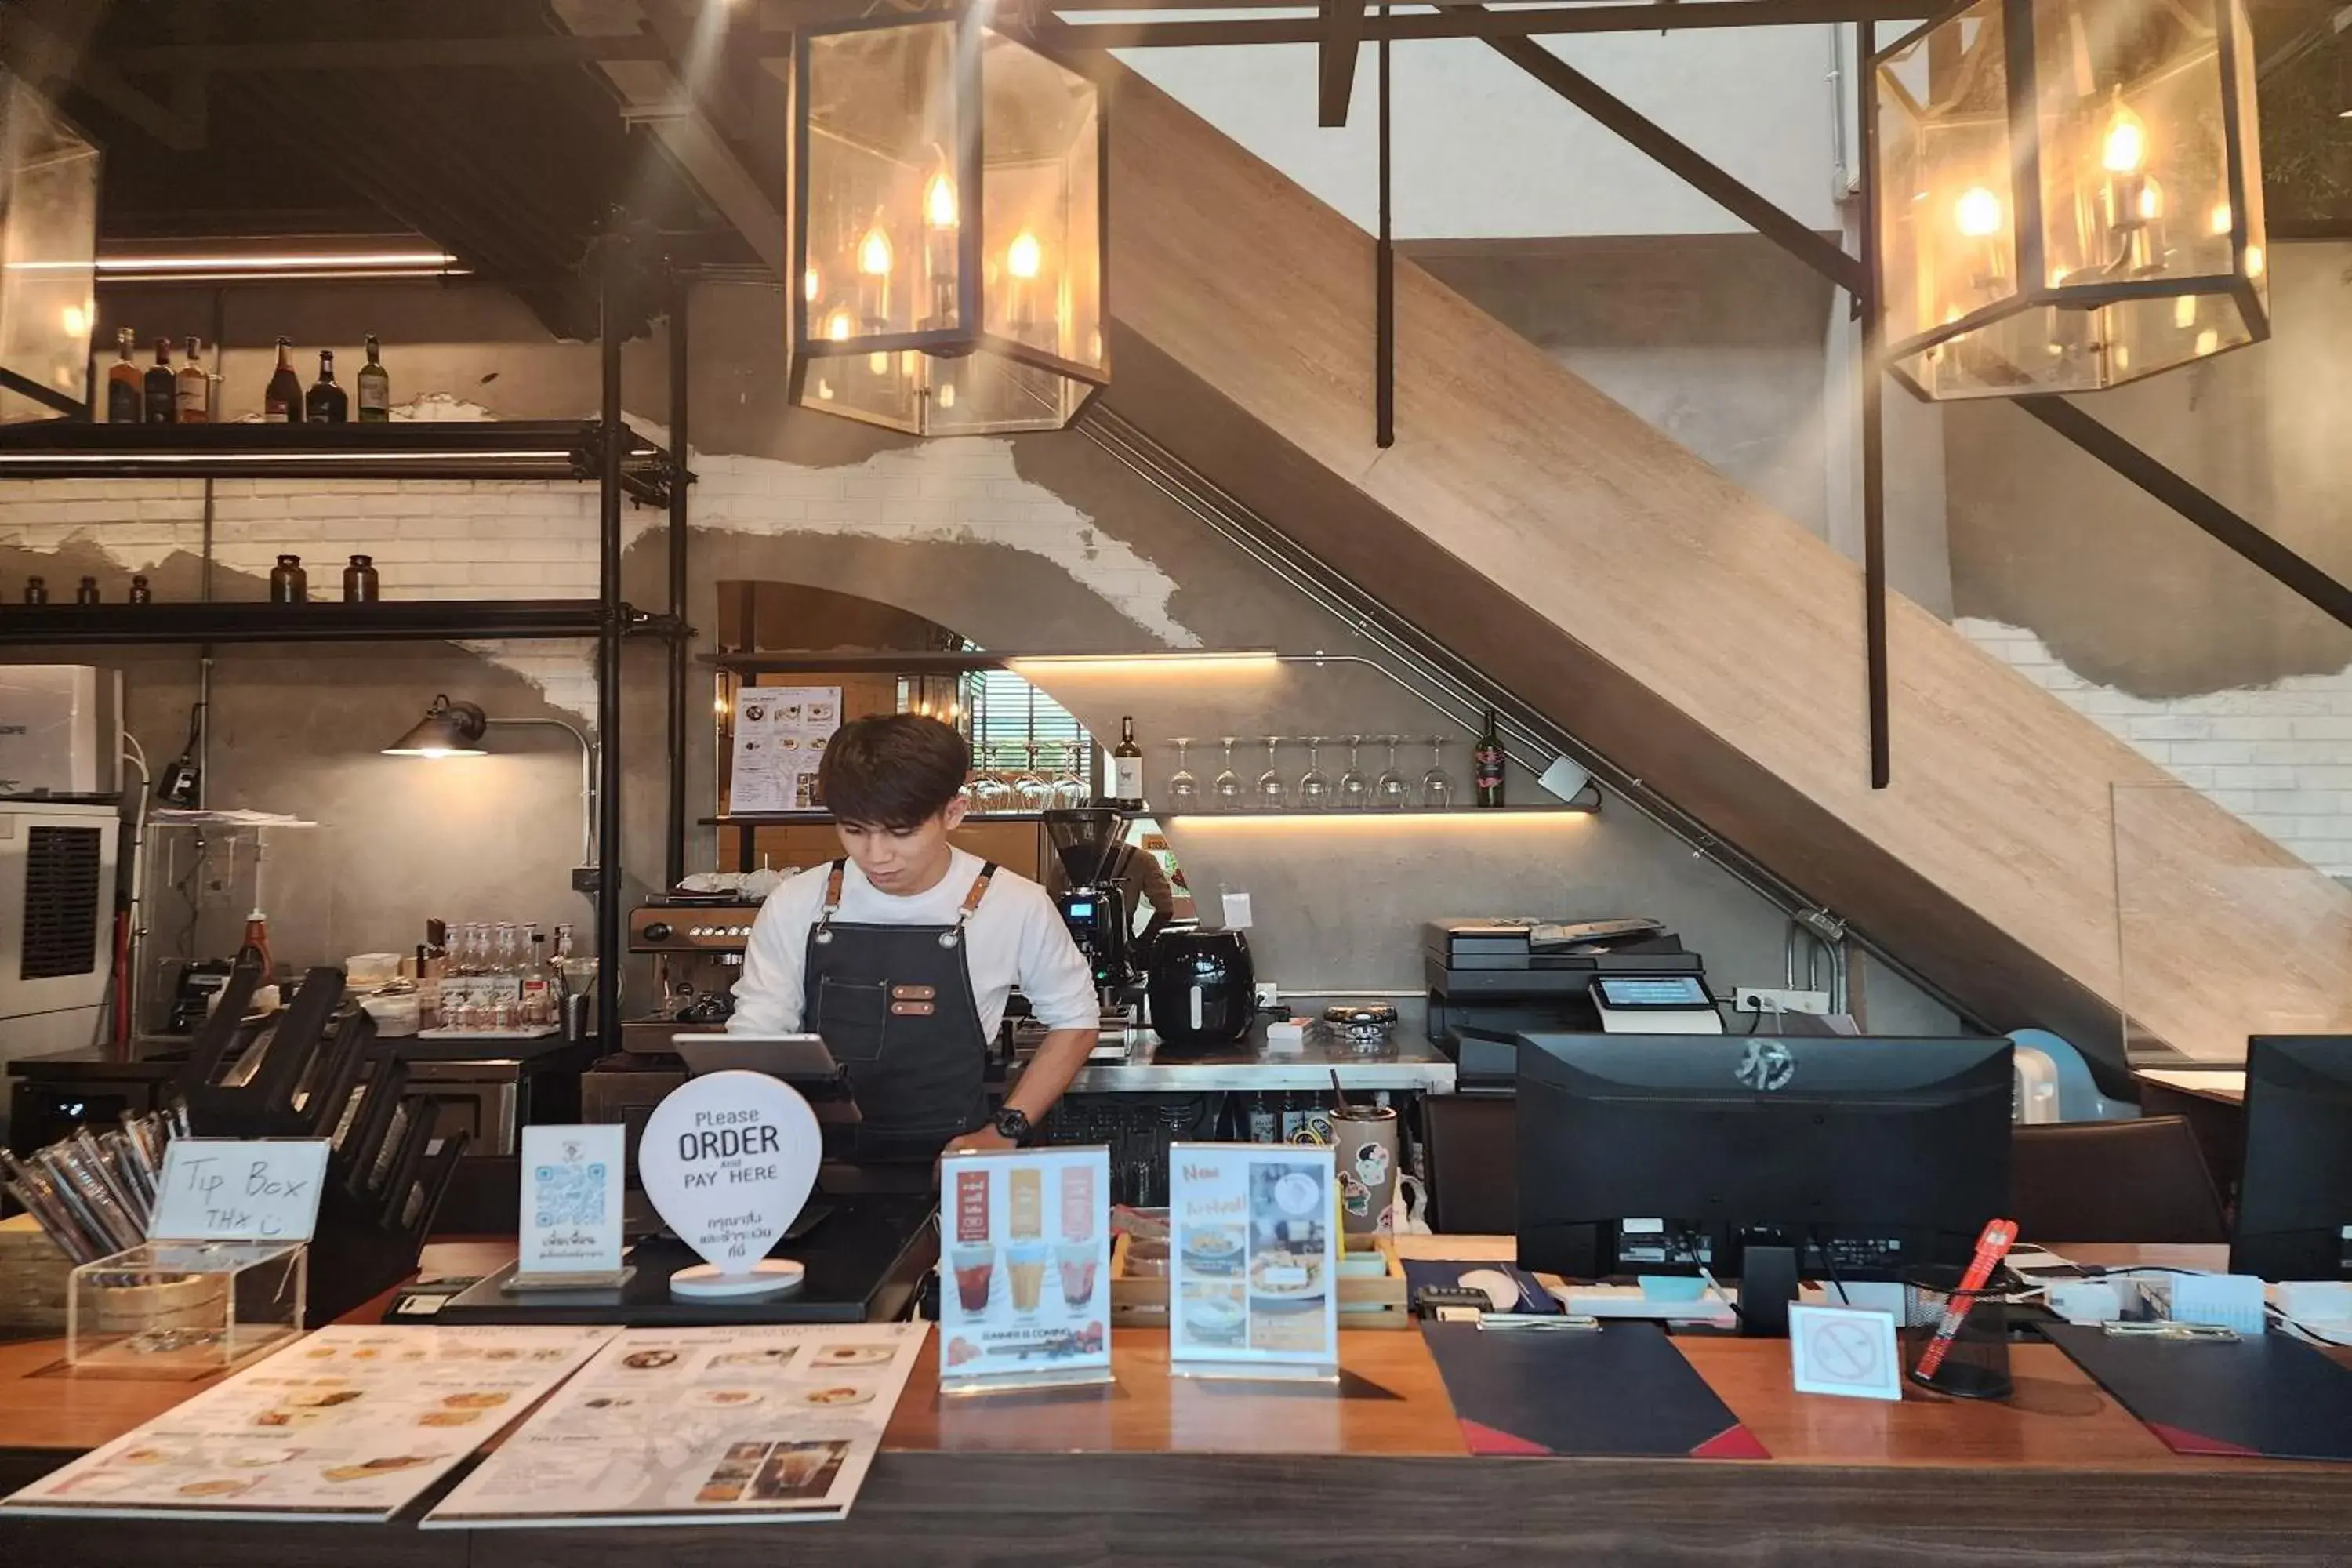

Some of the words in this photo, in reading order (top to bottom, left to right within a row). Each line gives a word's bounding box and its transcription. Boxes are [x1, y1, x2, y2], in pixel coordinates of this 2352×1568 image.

[695, 1109, 760, 1127] Please
[679, 1125, 779, 1162] ORDER
[245, 1161, 309, 1197] Box
[684, 1171, 717, 1189] PAY
[730, 1165, 777, 1184] HERE
